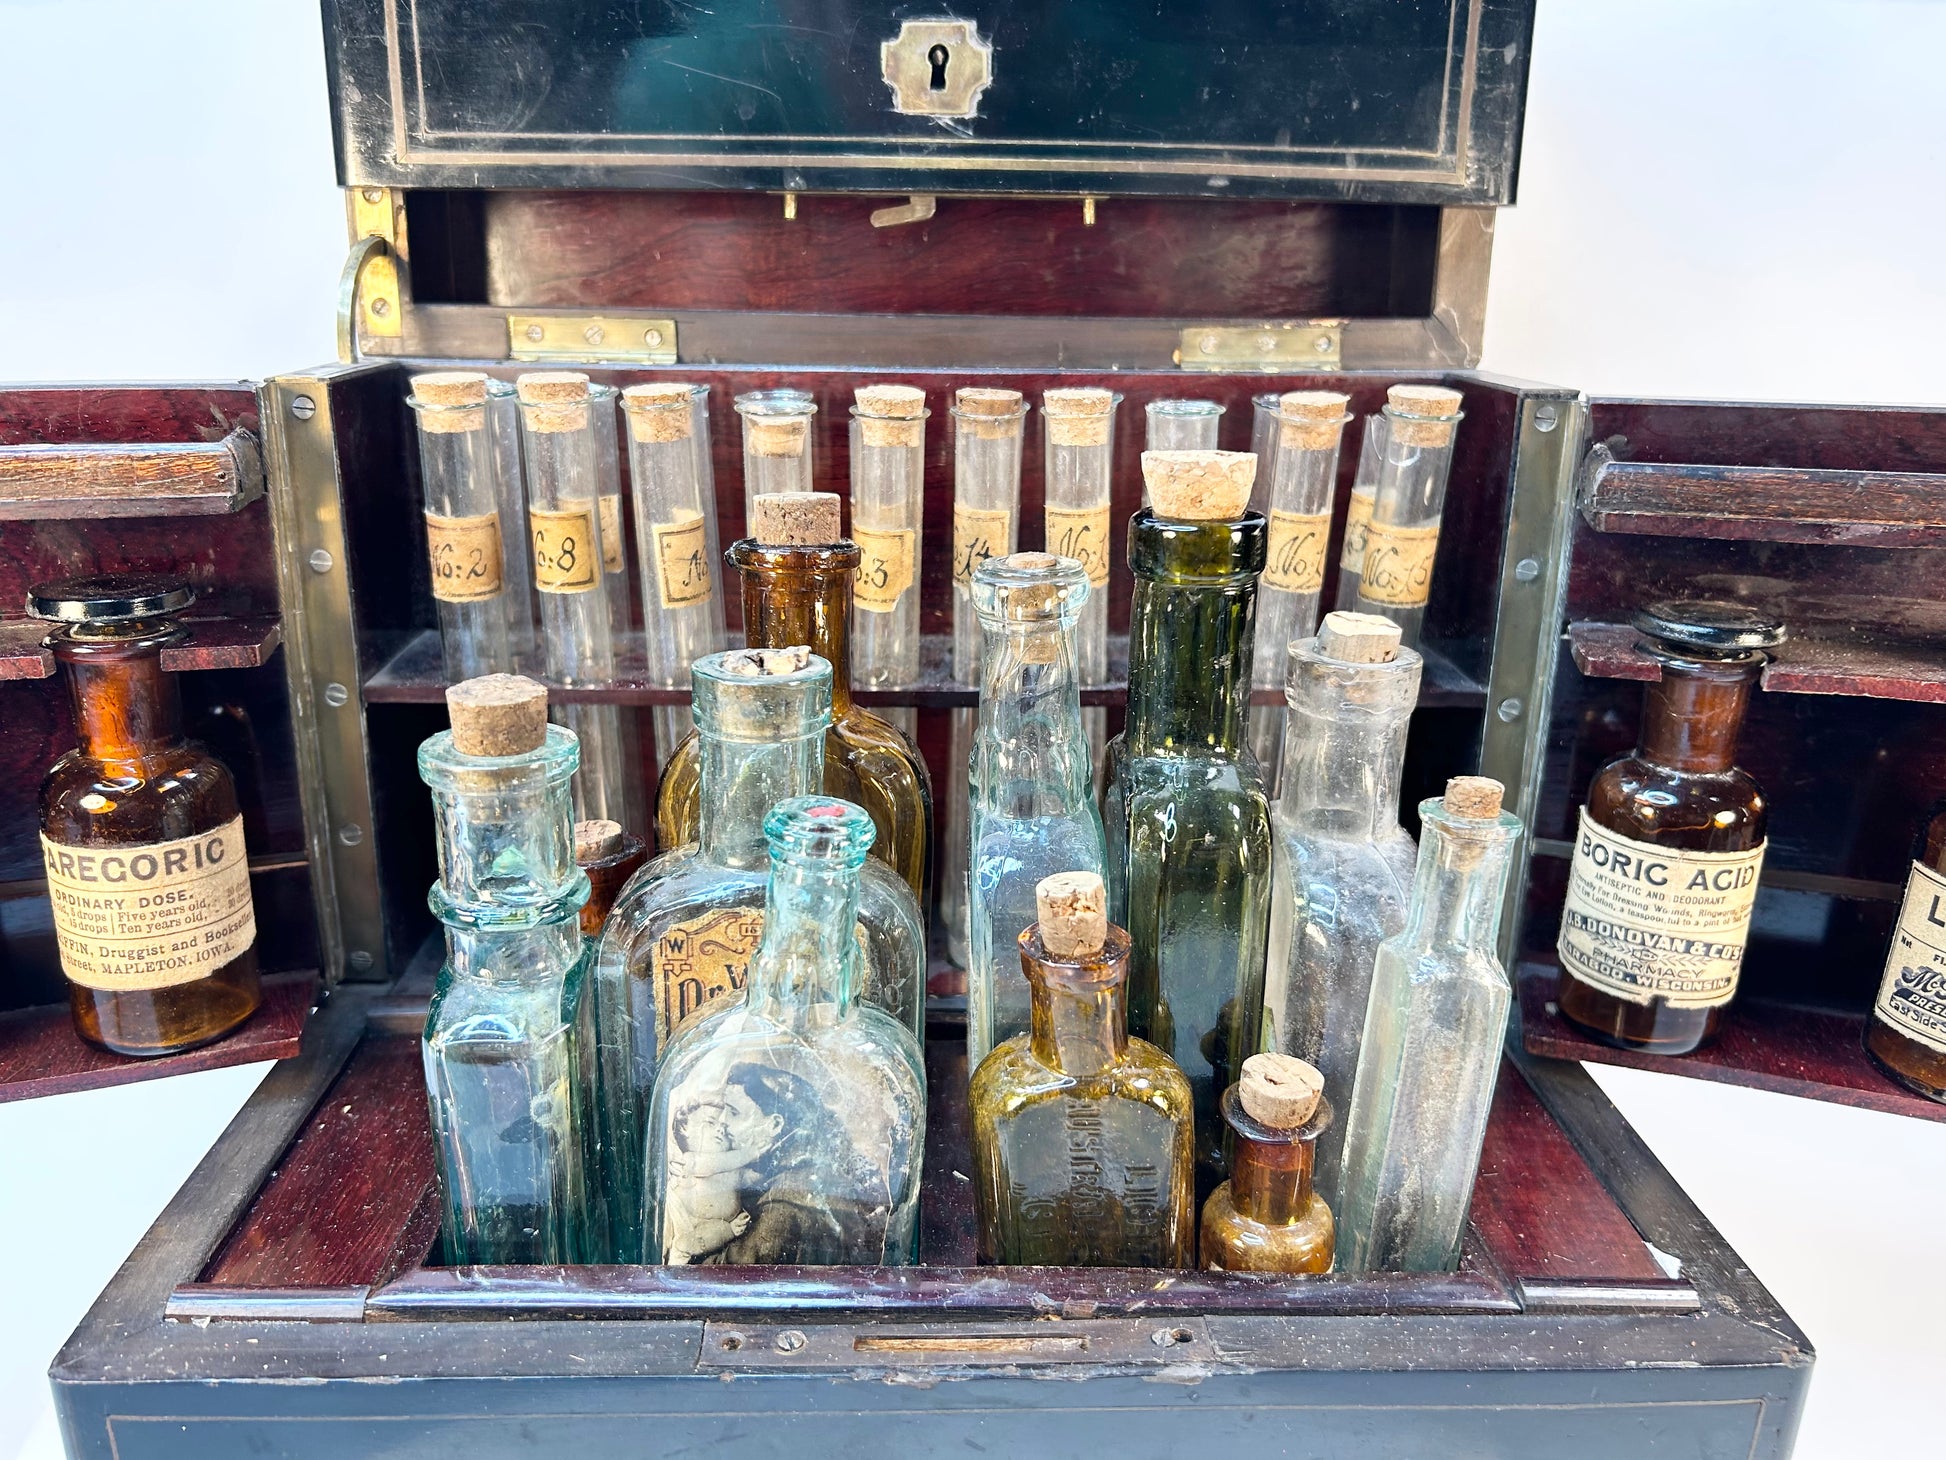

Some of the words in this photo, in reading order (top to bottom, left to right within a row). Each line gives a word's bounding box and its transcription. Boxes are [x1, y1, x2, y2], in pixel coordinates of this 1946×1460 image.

[856, 547, 888, 588] o:3
[44, 838, 225, 883] AREGORIC
[1581, 832, 1669, 887] BORIC
[1686, 865, 1755, 892] ACID
[56, 889, 125, 910] ORDINARY
[139, 889, 193, 908] DOSE.
[1595, 872, 1642, 896] ANTISEPTIC
[1645, 890, 1665, 901] AND
[1673, 895, 1726, 906] DEODORANT
[1598, 886, 1610, 898] For
[1612, 893, 1649, 911] Dressing
[77, 909, 107, 922] drops
[117, 911, 147, 922] Five
[150, 906, 185, 922] years
[188, 898, 211, 913] old,
[1592, 893, 1616, 912] Lotion,
[1683, 918, 1691, 926] to
[1704, 919, 1719, 928] pint
[69, 918, 77, 929] 15
[78, 921, 109, 935] drops
[118, 923, 142, 934] Ten
[146, 919, 181, 933] years
[99, 944, 165, 961] Druggist
[171, 936, 198, 952] and
[196, 942, 235, 962] IOWA.
[667, 938, 684, 954] W
[1690, 940, 1707, 956] &
[1593, 946, 1705, 978] PHARMACY
[1889, 994, 1910, 1017] East
[1911, 1009, 1937, 1030] Side
[1908, 993, 1946, 1018] PRES
